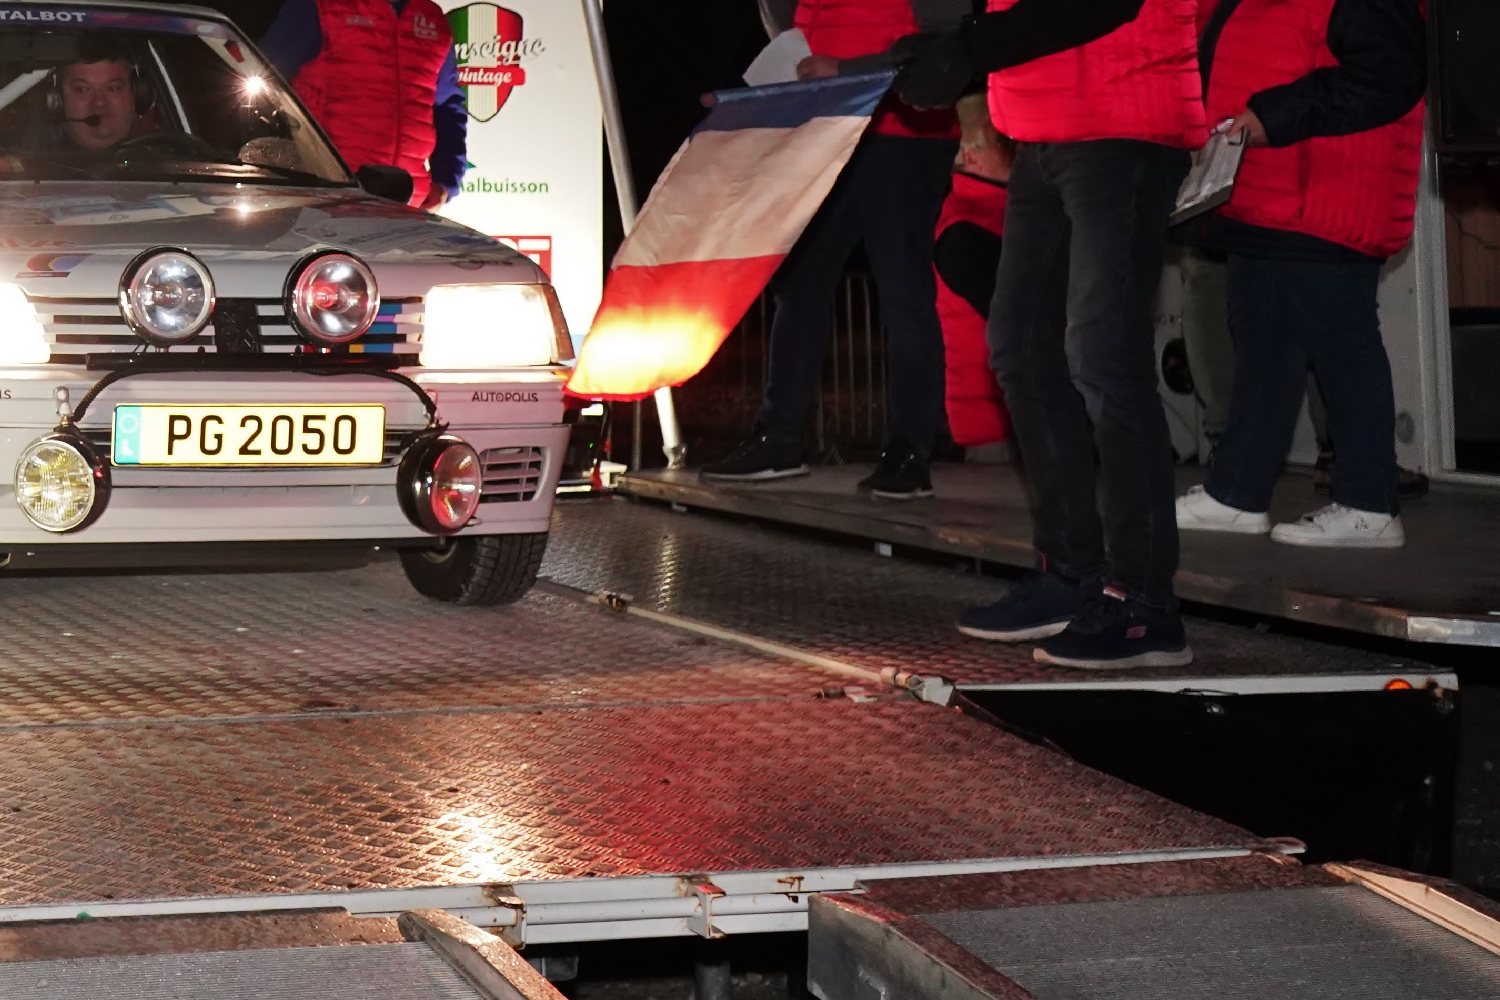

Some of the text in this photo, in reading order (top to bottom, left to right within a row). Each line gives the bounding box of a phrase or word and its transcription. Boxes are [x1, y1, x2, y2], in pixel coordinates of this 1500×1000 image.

[0, 10, 86, 22] TALBOT
[460, 177, 549, 193] albuisson
[471, 391, 539, 403] AUTOPOLIS
[122, 414, 357, 456] L PG 2050
